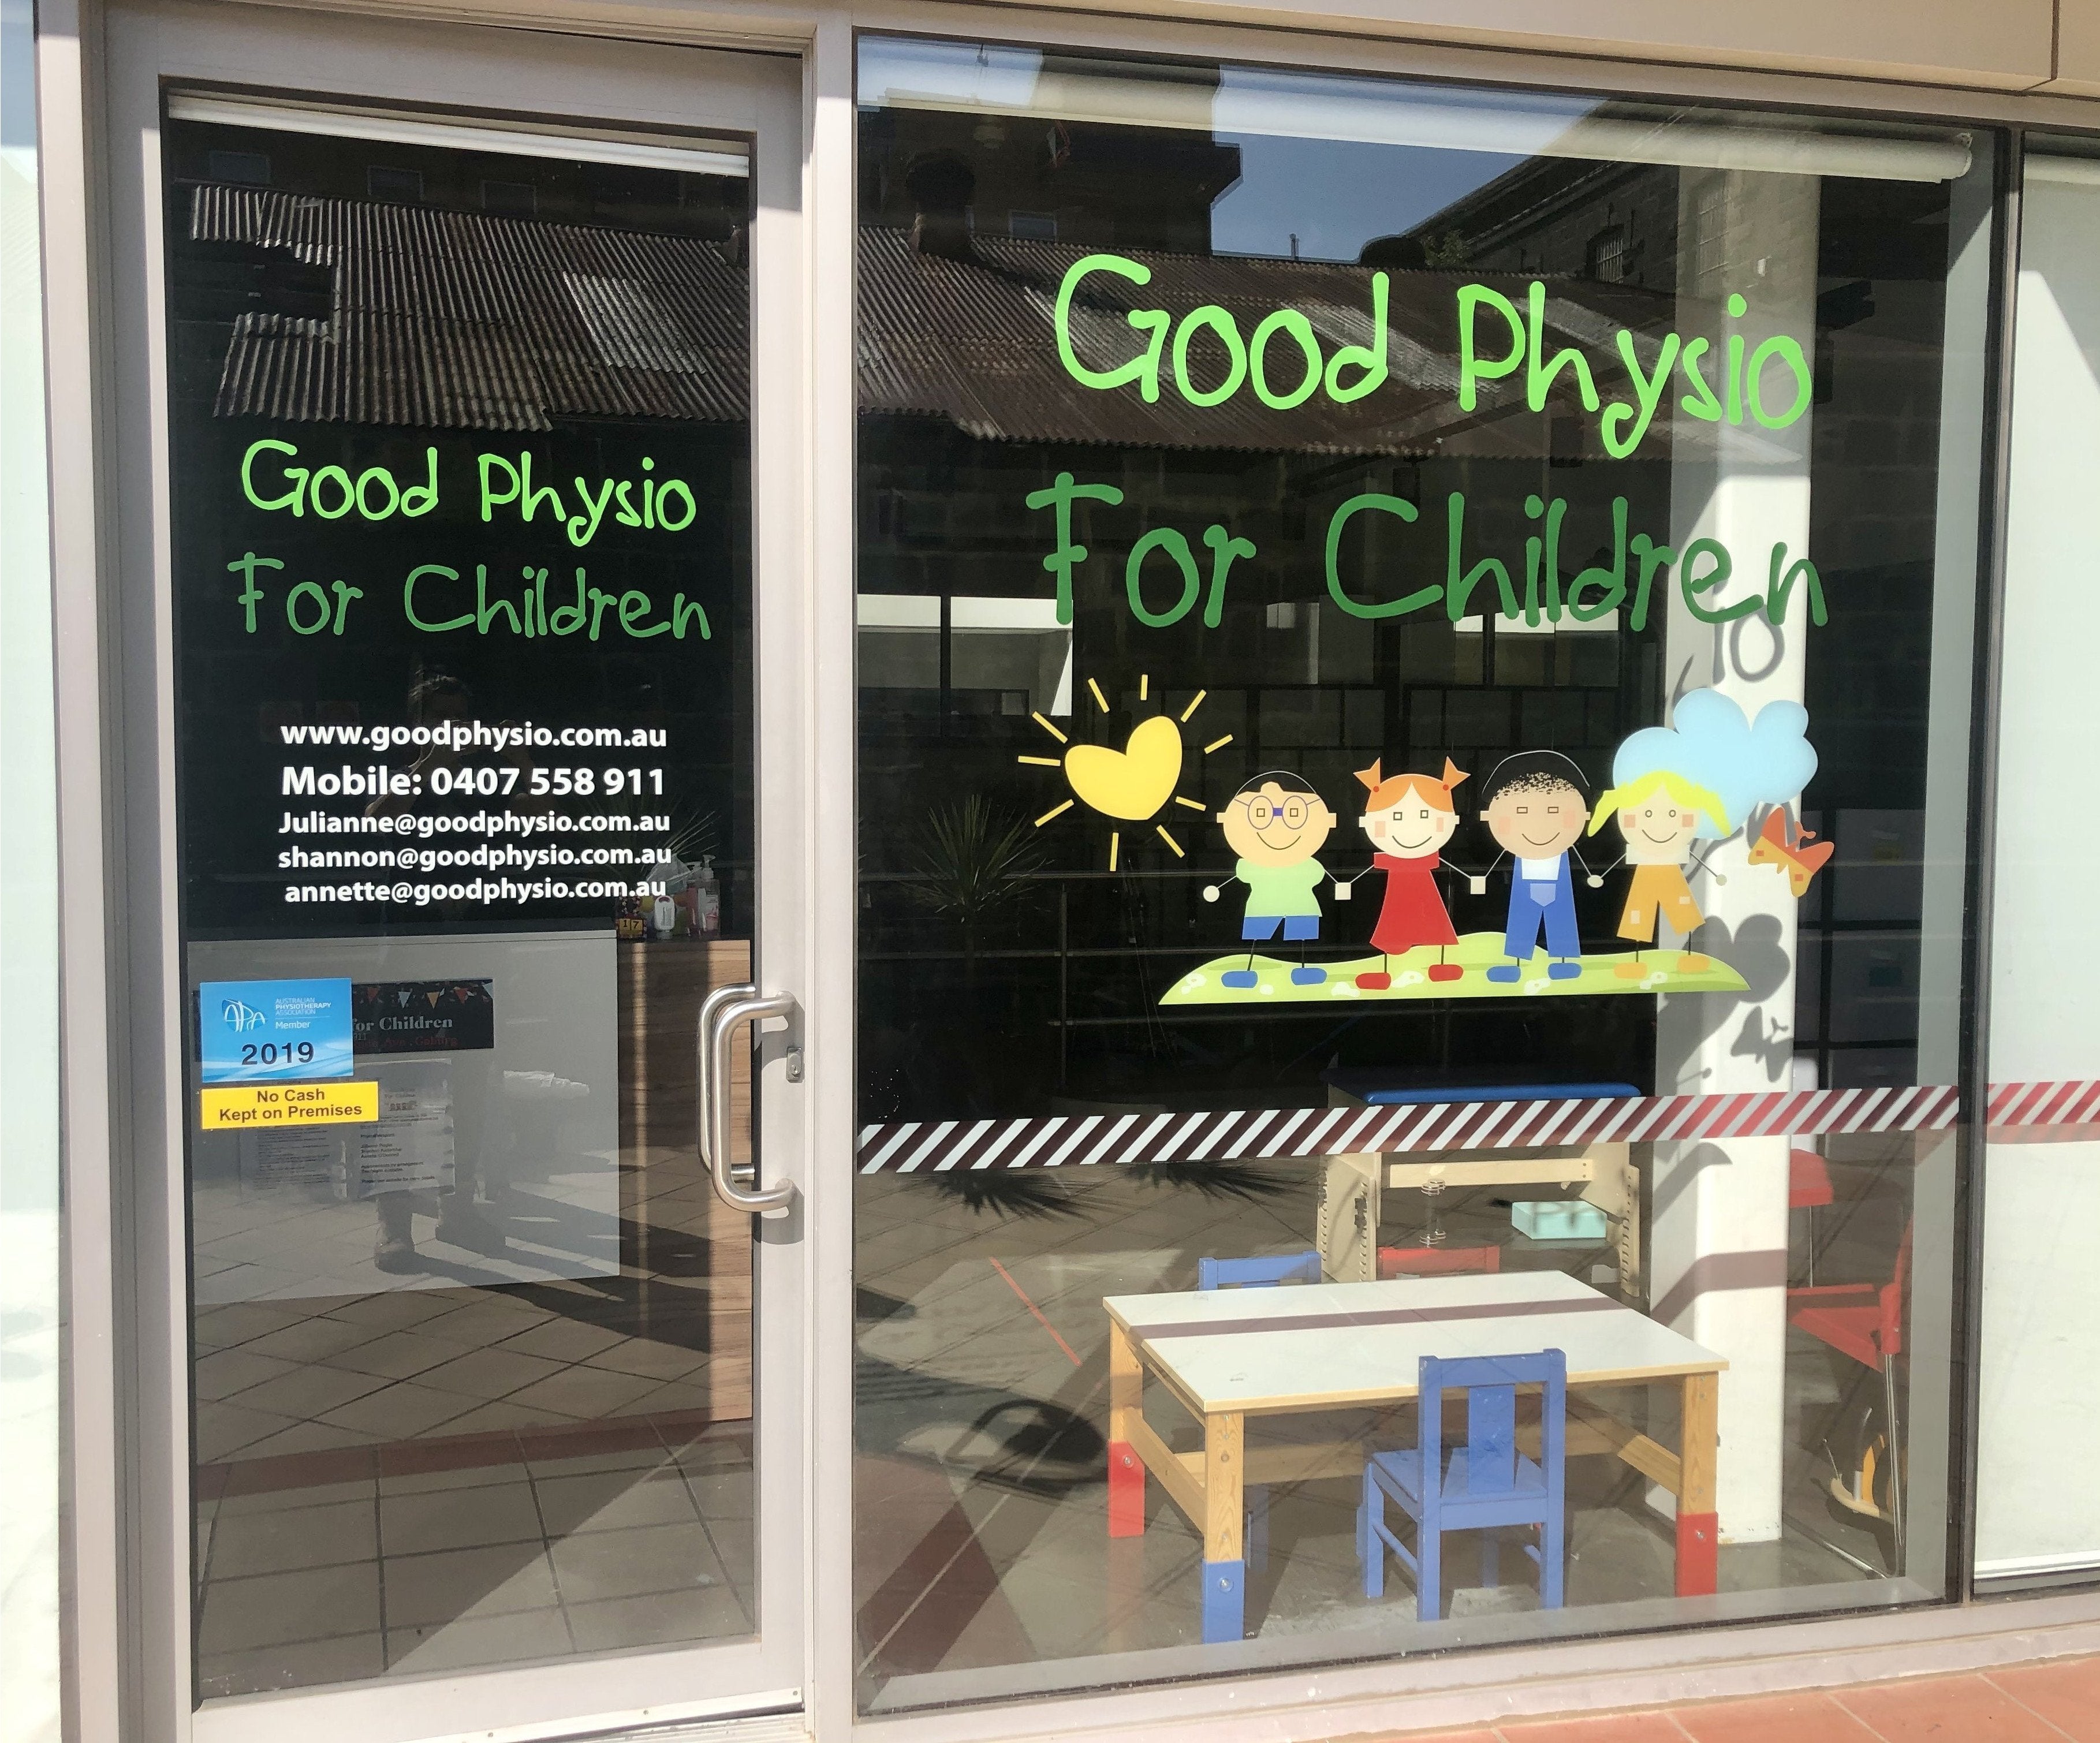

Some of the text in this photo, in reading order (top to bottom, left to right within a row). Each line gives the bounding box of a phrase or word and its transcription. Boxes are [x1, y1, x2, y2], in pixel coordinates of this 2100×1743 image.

[1054, 253, 1813, 459] Good Physio
[241, 438, 696, 547] Good Physio
[1025, 472, 1827, 632] For Children
[227, 552, 711, 641] For Children
[281, 720, 667, 750] www.goodphysio.com.au
[282, 765, 662, 796] Mobile: 0407 558 911
[278, 810, 670, 838] Julianne@goodphysio.com.au
[278, 843, 672, 871] shannon@goodphysio.com.au
[284, 877, 667, 906] annette@goodphysio.com.au
[275, 1021, 311, 1029] Member
[379, 1016, 453, 1030] Children
[241, 1042, 314, 1065] 2019
[257, 1088, 325, 1103] No Cash
[220, 1104, 363, 1123] Kept on Premises
